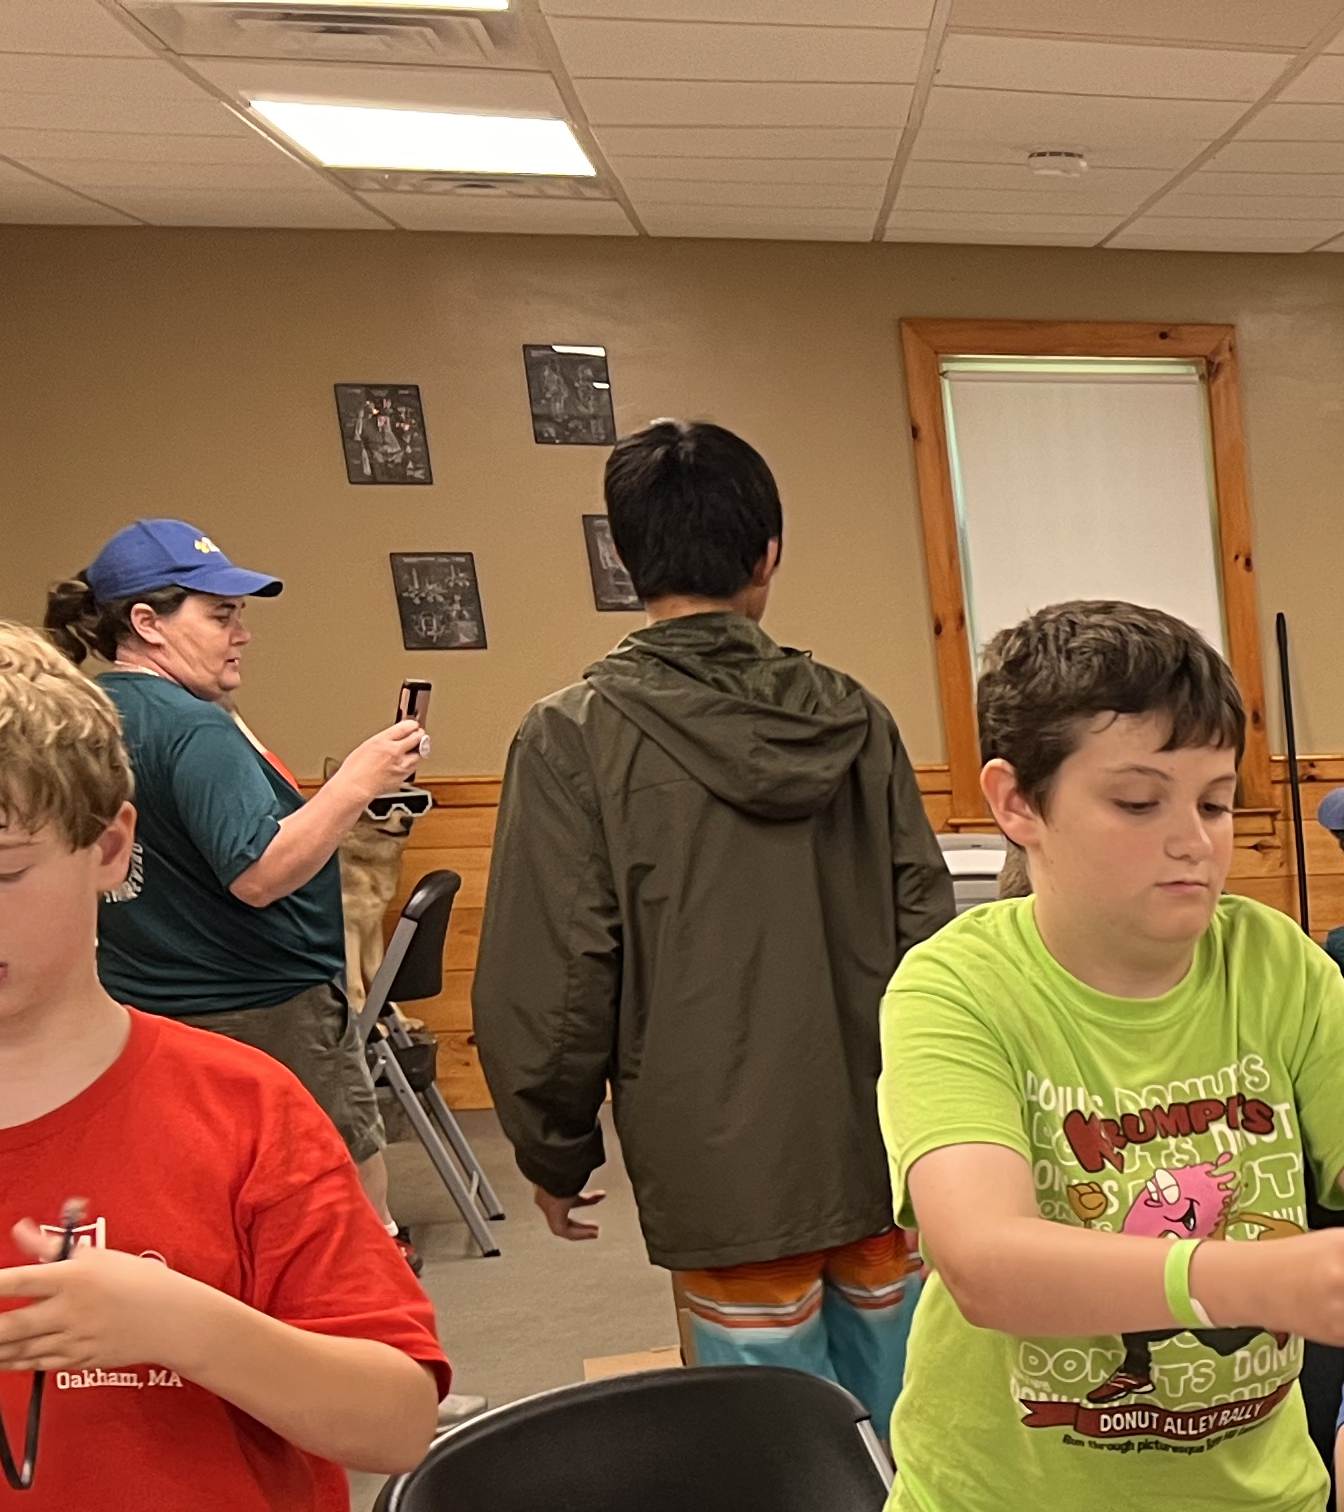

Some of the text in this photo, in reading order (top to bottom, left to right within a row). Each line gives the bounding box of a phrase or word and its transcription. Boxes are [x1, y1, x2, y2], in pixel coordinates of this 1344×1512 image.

[56, 1368, 184, 1391] Oakham, MA
[1100, 1411, 1160, 1432] DONUT
[1164, 1411, 1218, 1435] ALLEY
[1218, 1402, 1263, 1426] RALLY
[1088, 1440, 1135, 1454] through
[1137, 1440, 1205, 1455] picturesque
